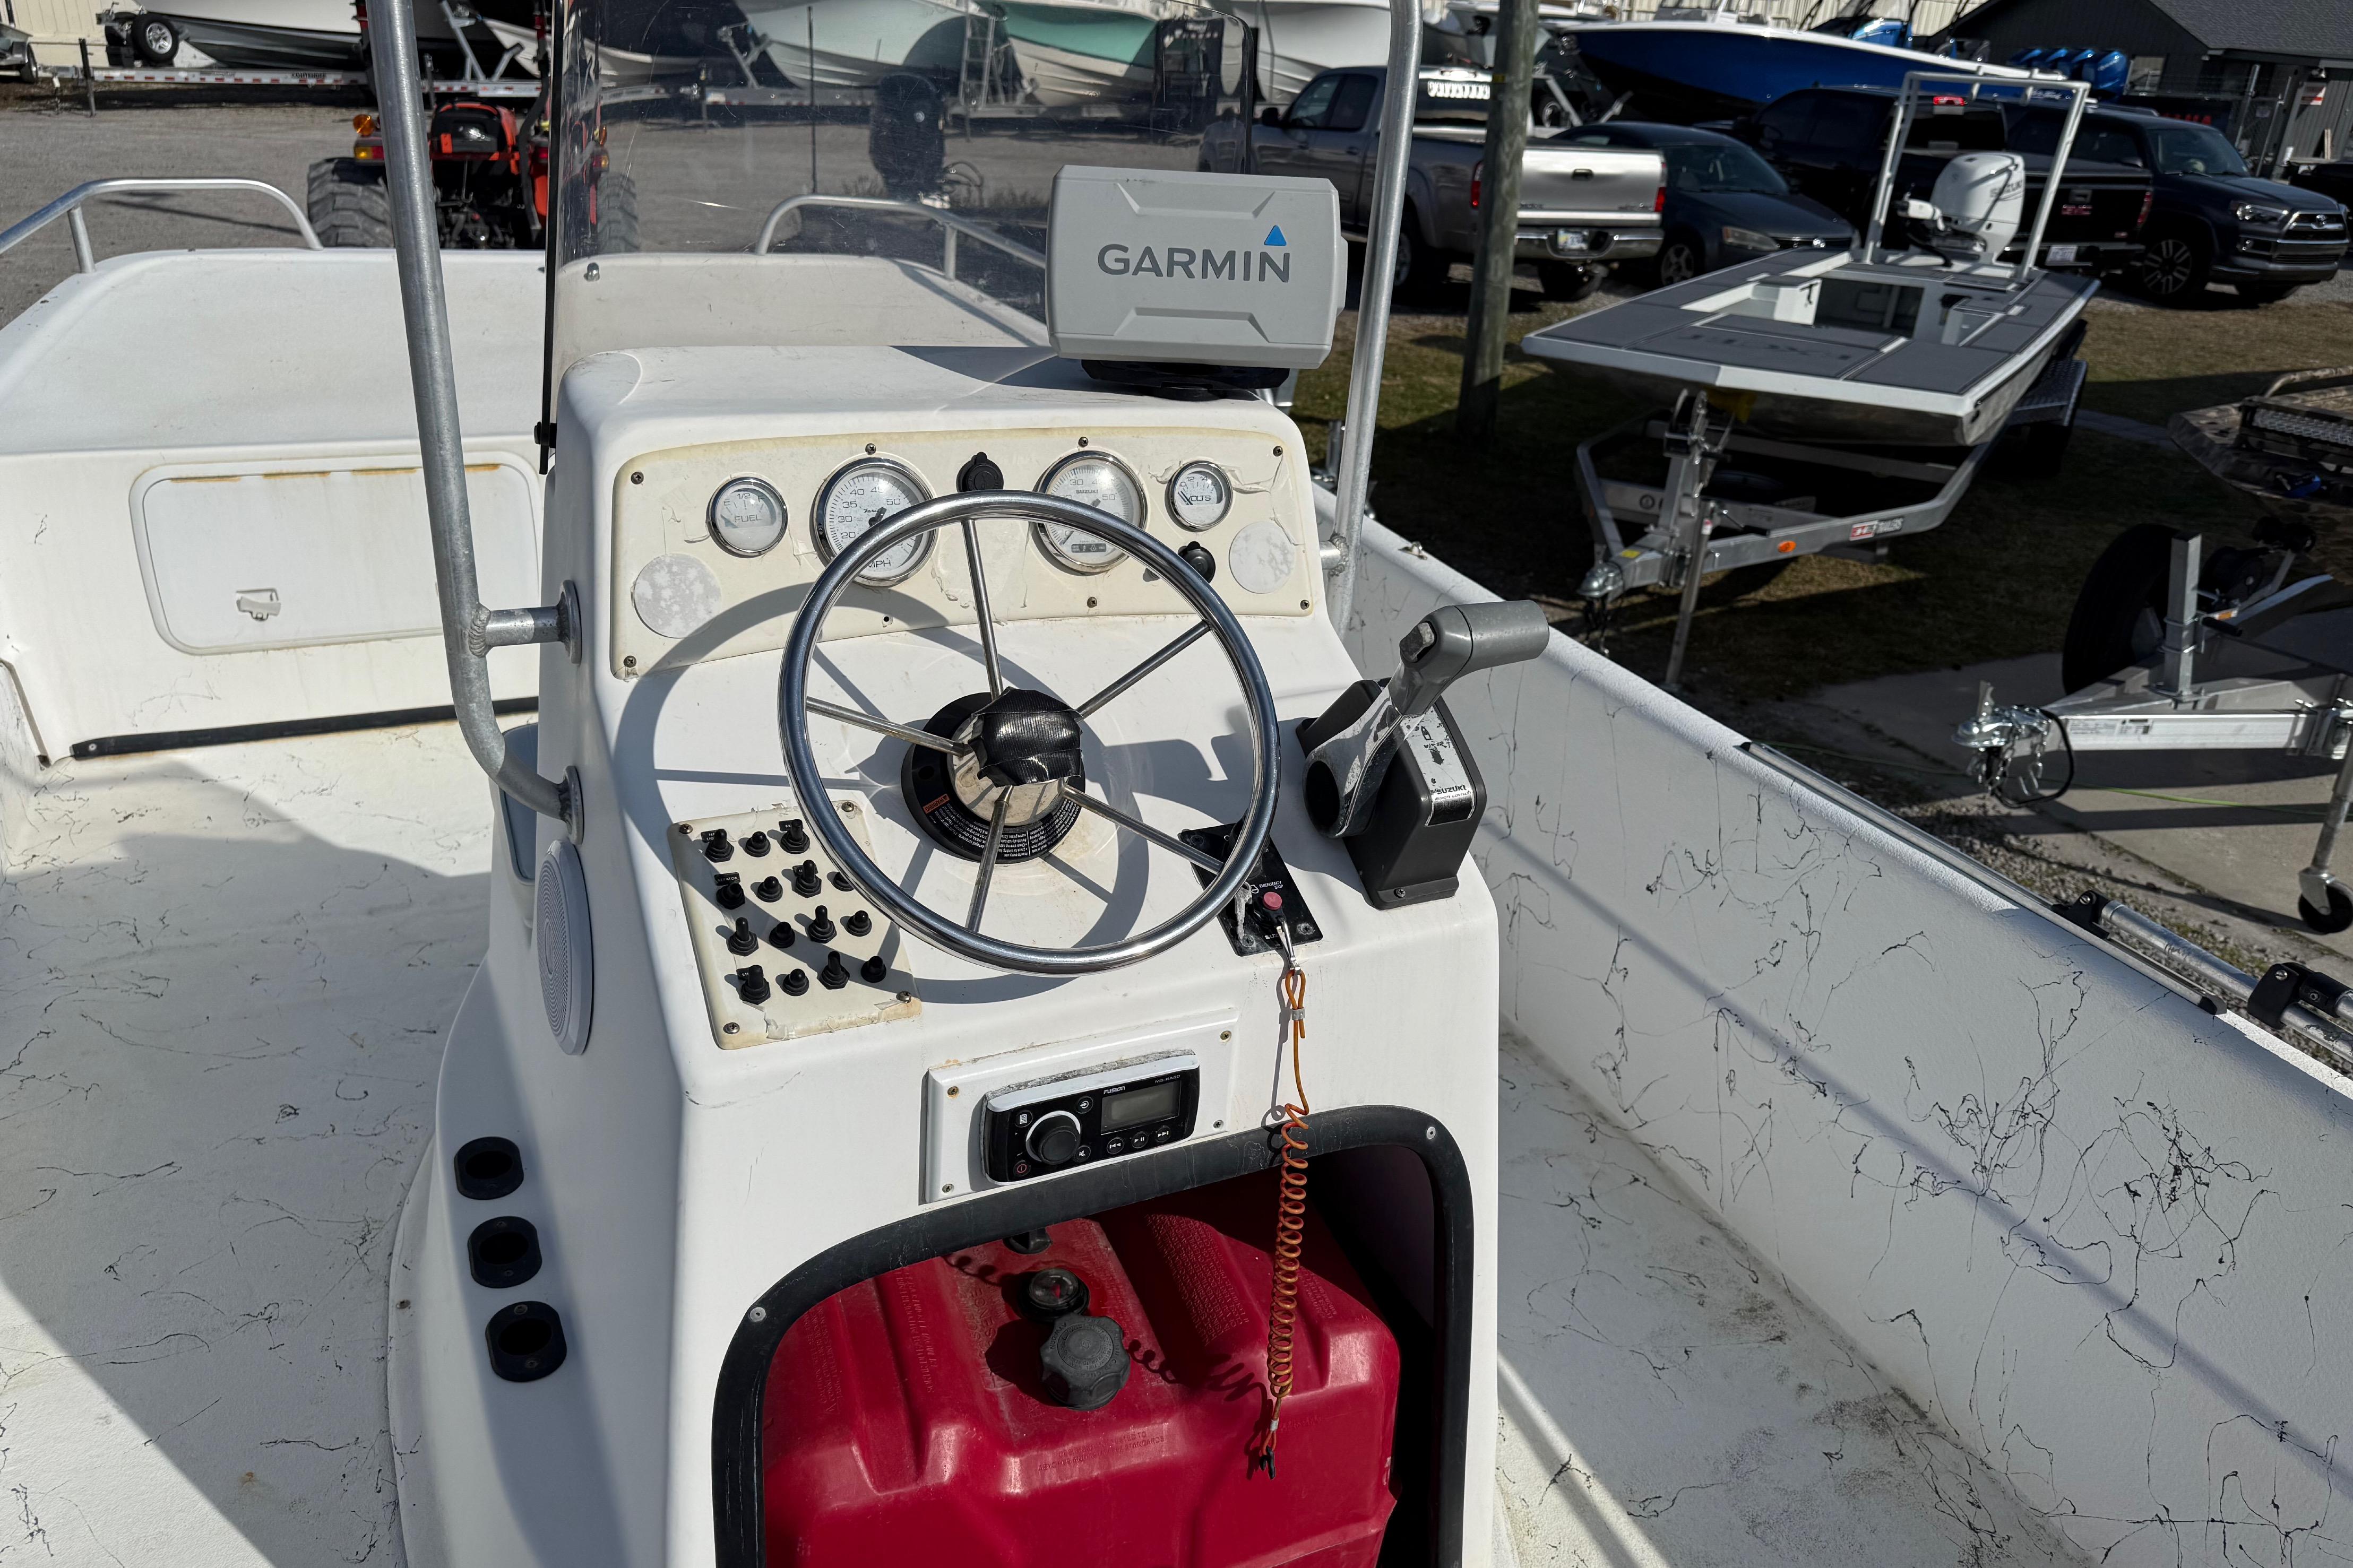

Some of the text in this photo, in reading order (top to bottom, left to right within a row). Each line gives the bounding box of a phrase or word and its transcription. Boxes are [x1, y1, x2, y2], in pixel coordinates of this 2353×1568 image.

[1098, 244, 1290, 283] GARMIN
[1436, 785, 1467, 794] SUZUKI
[925, 797, 944, 812] WARNING
